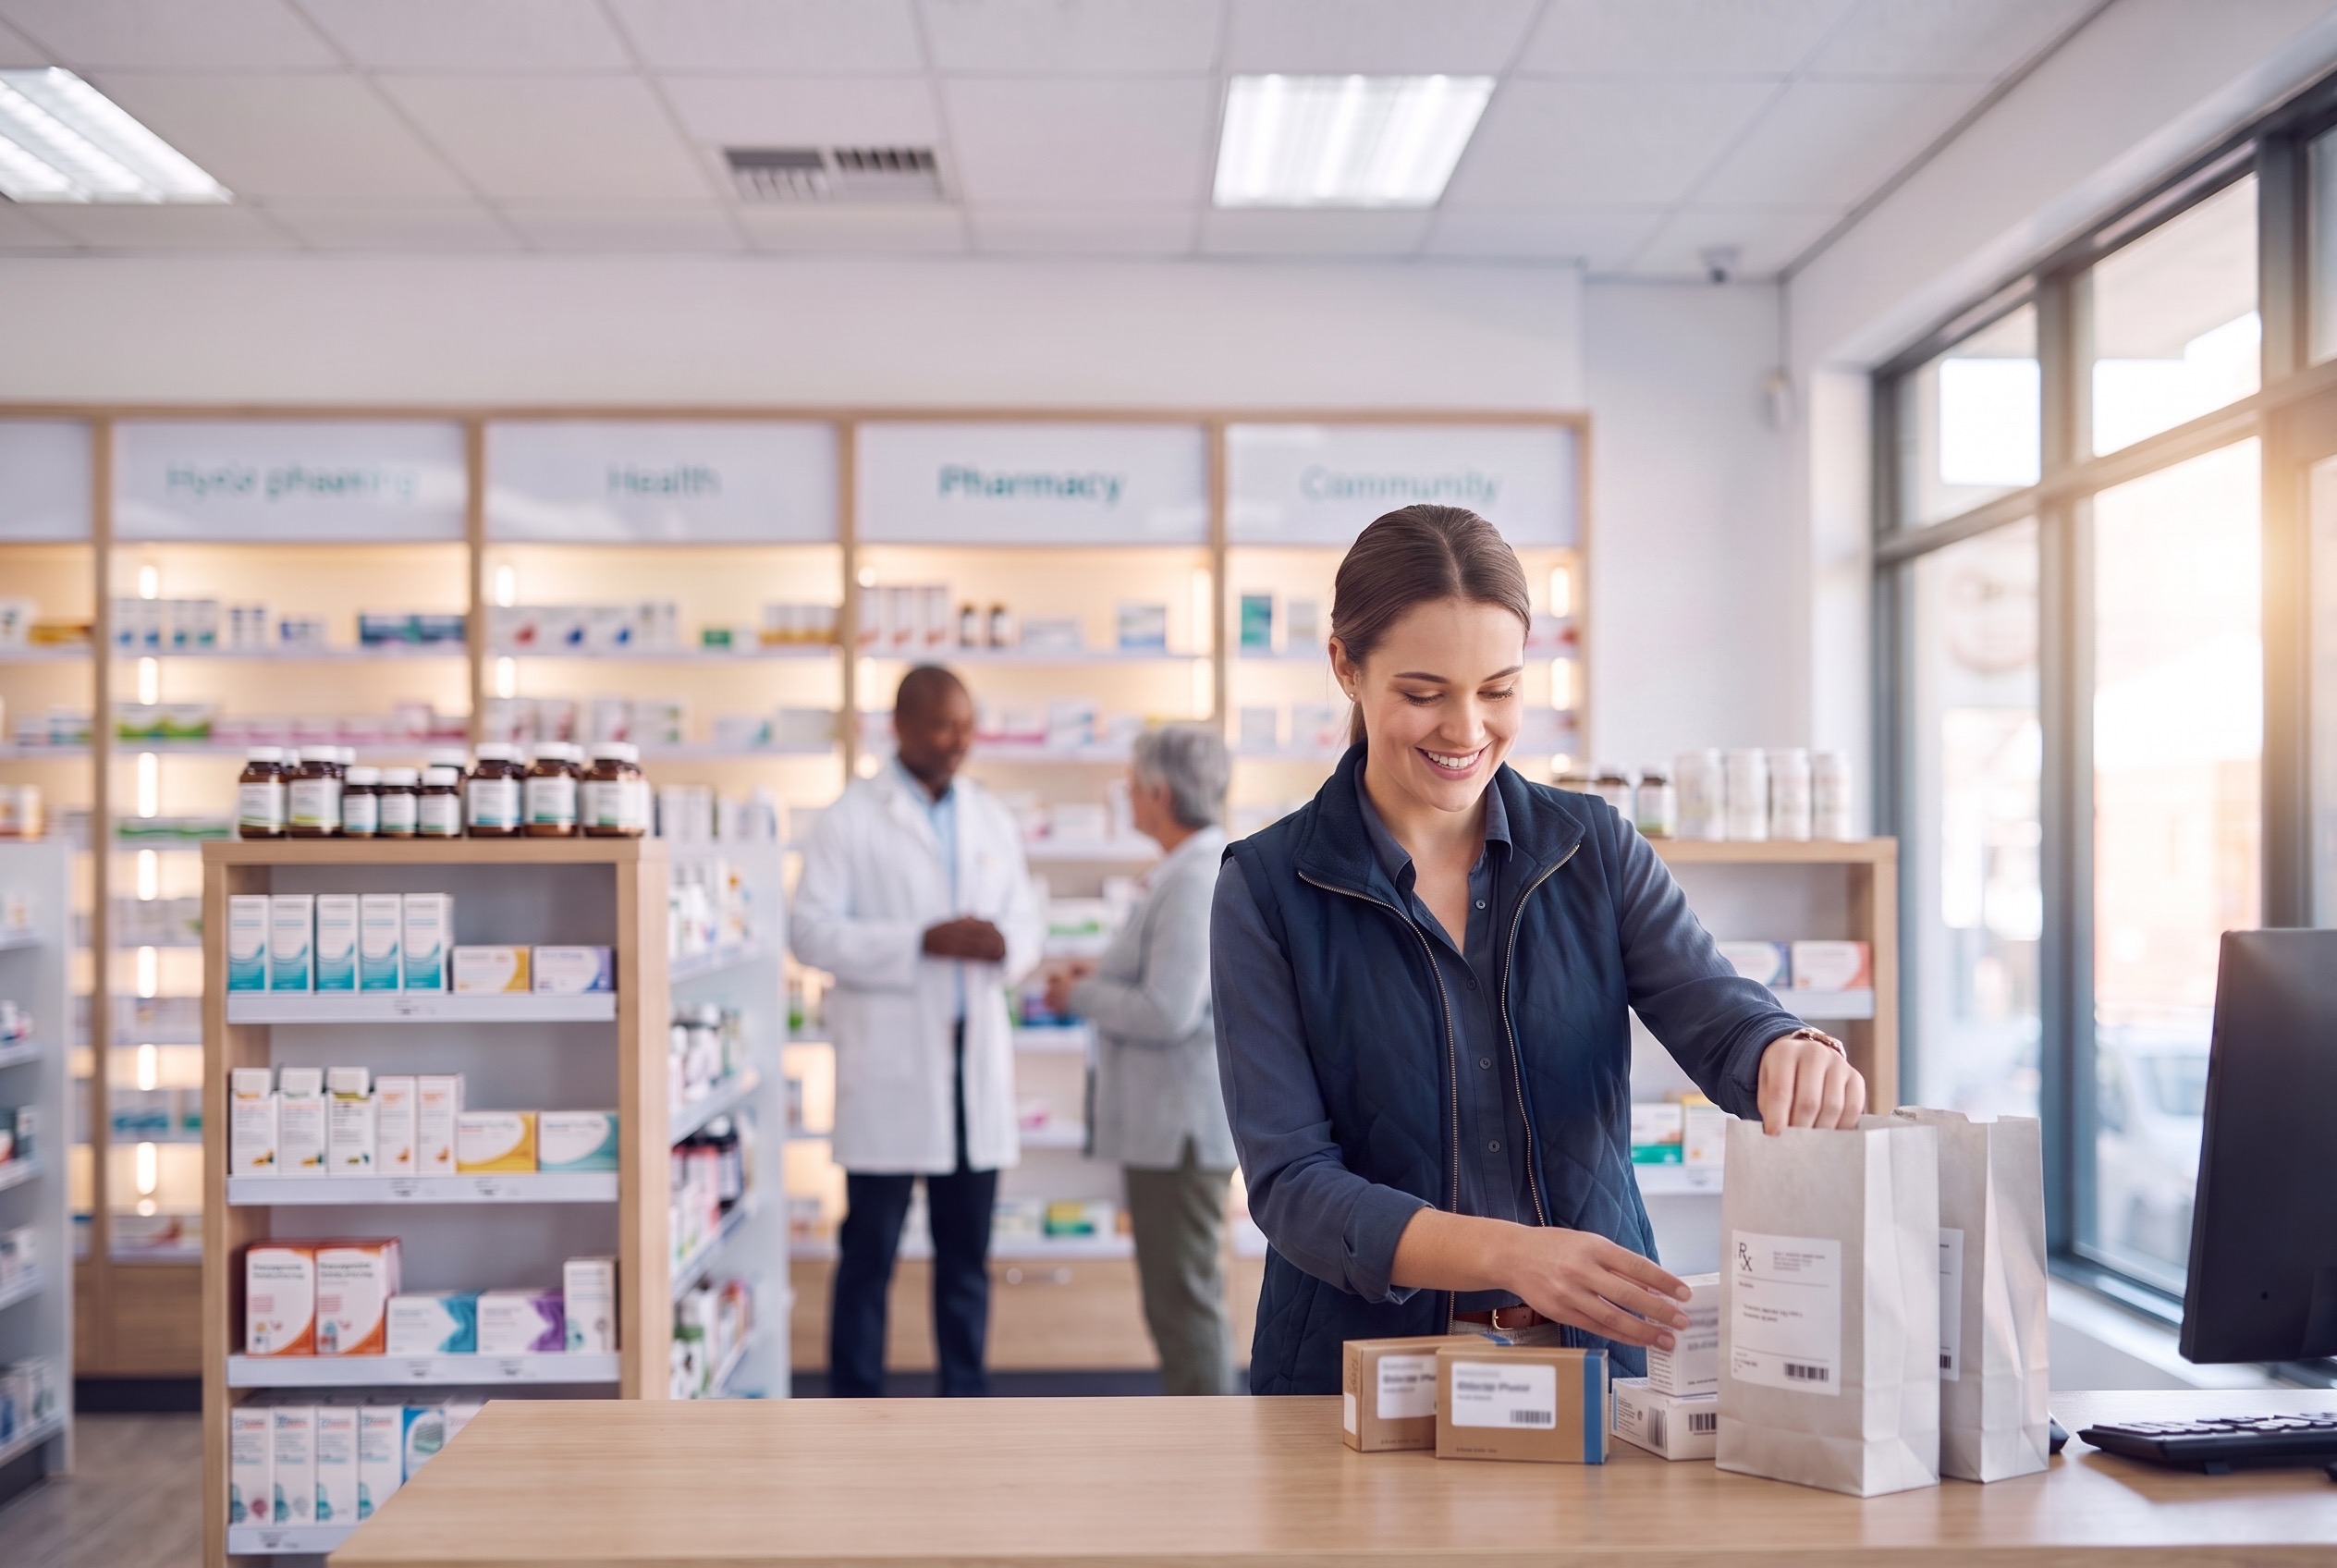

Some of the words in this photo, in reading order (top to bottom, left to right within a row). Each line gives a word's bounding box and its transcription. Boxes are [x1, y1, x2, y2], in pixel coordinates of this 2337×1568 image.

[606, 464, 720, 496] Health
[937, 465, 1124, 506] Pharmacy
[1299, 464, 1501, 505] Community
